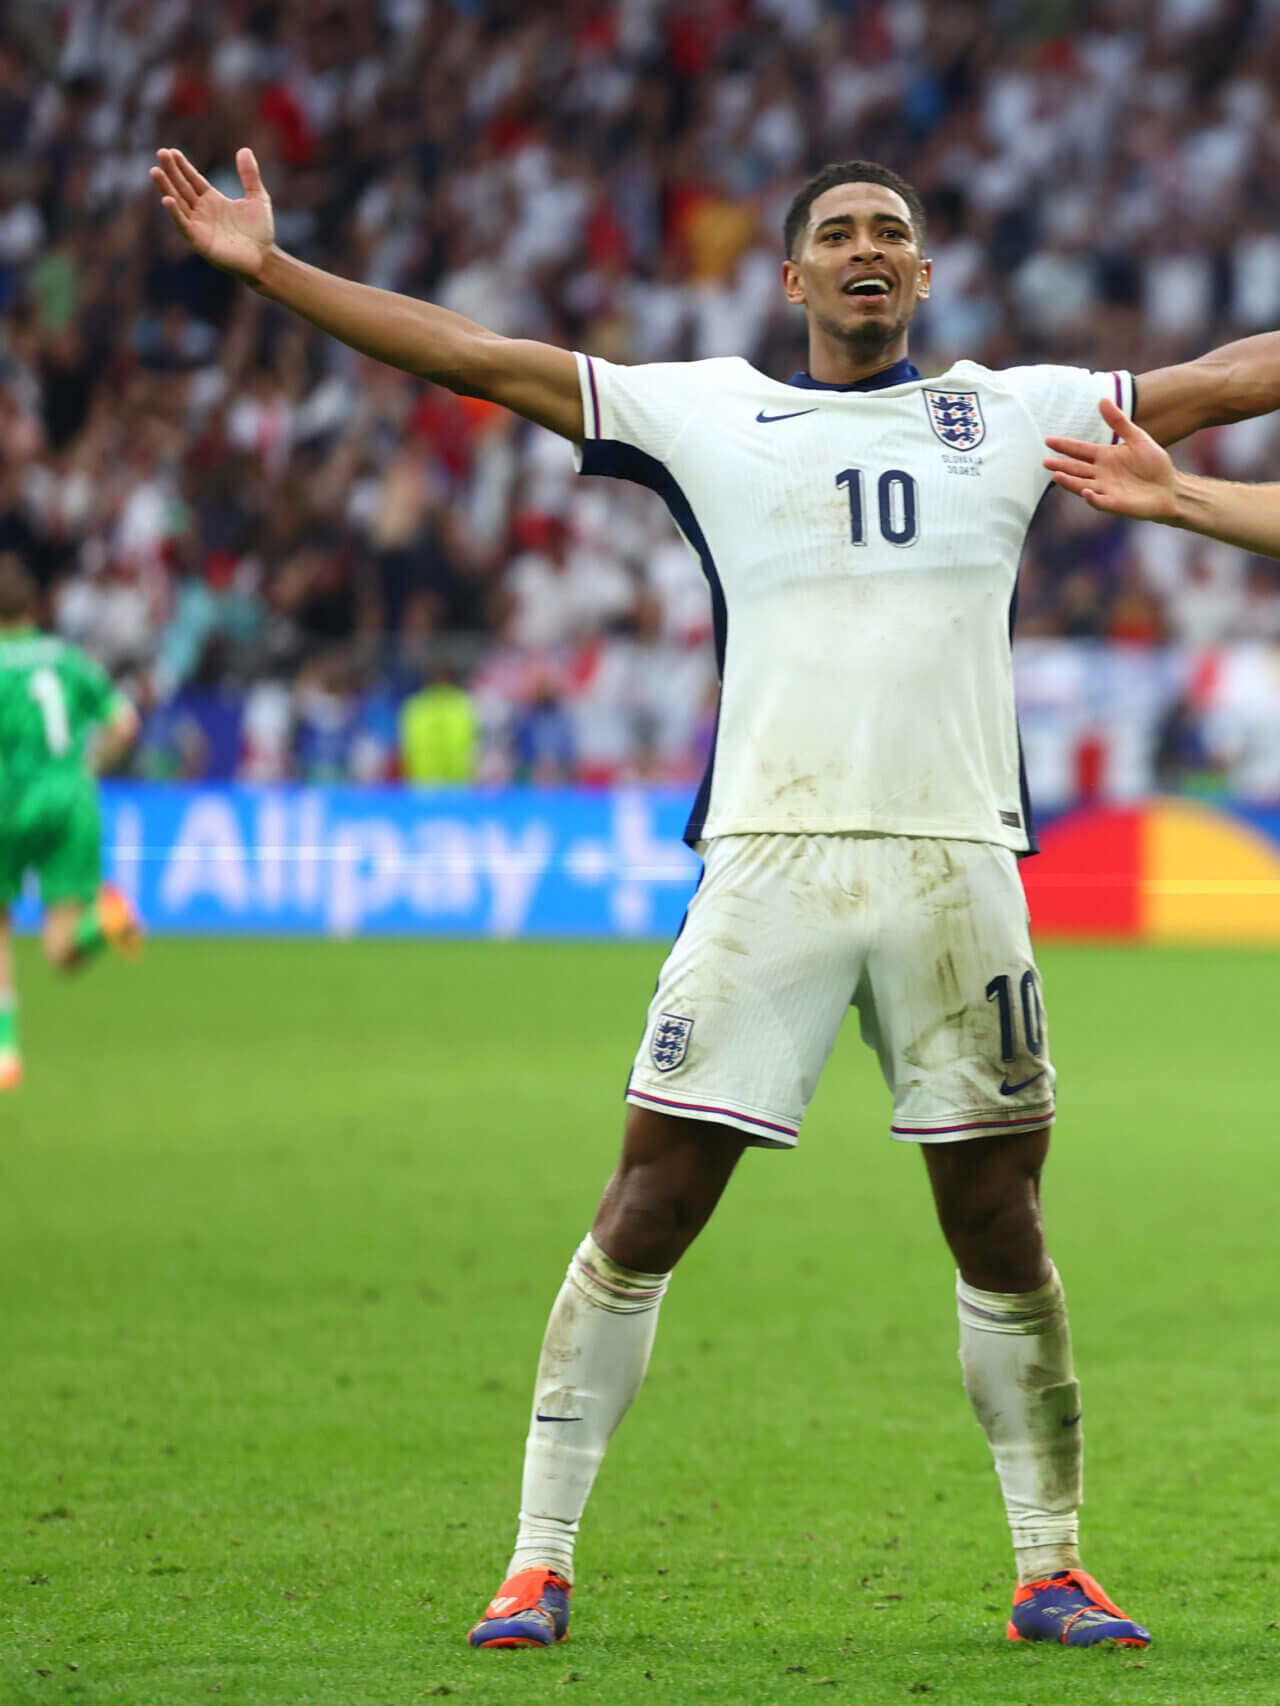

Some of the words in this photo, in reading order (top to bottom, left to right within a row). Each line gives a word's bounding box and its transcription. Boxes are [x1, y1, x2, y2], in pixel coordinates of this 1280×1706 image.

[835, 468, 920, 549] 10
[30, 667, 69, 756] 1
[985, 970, 1042, 1062] 10
